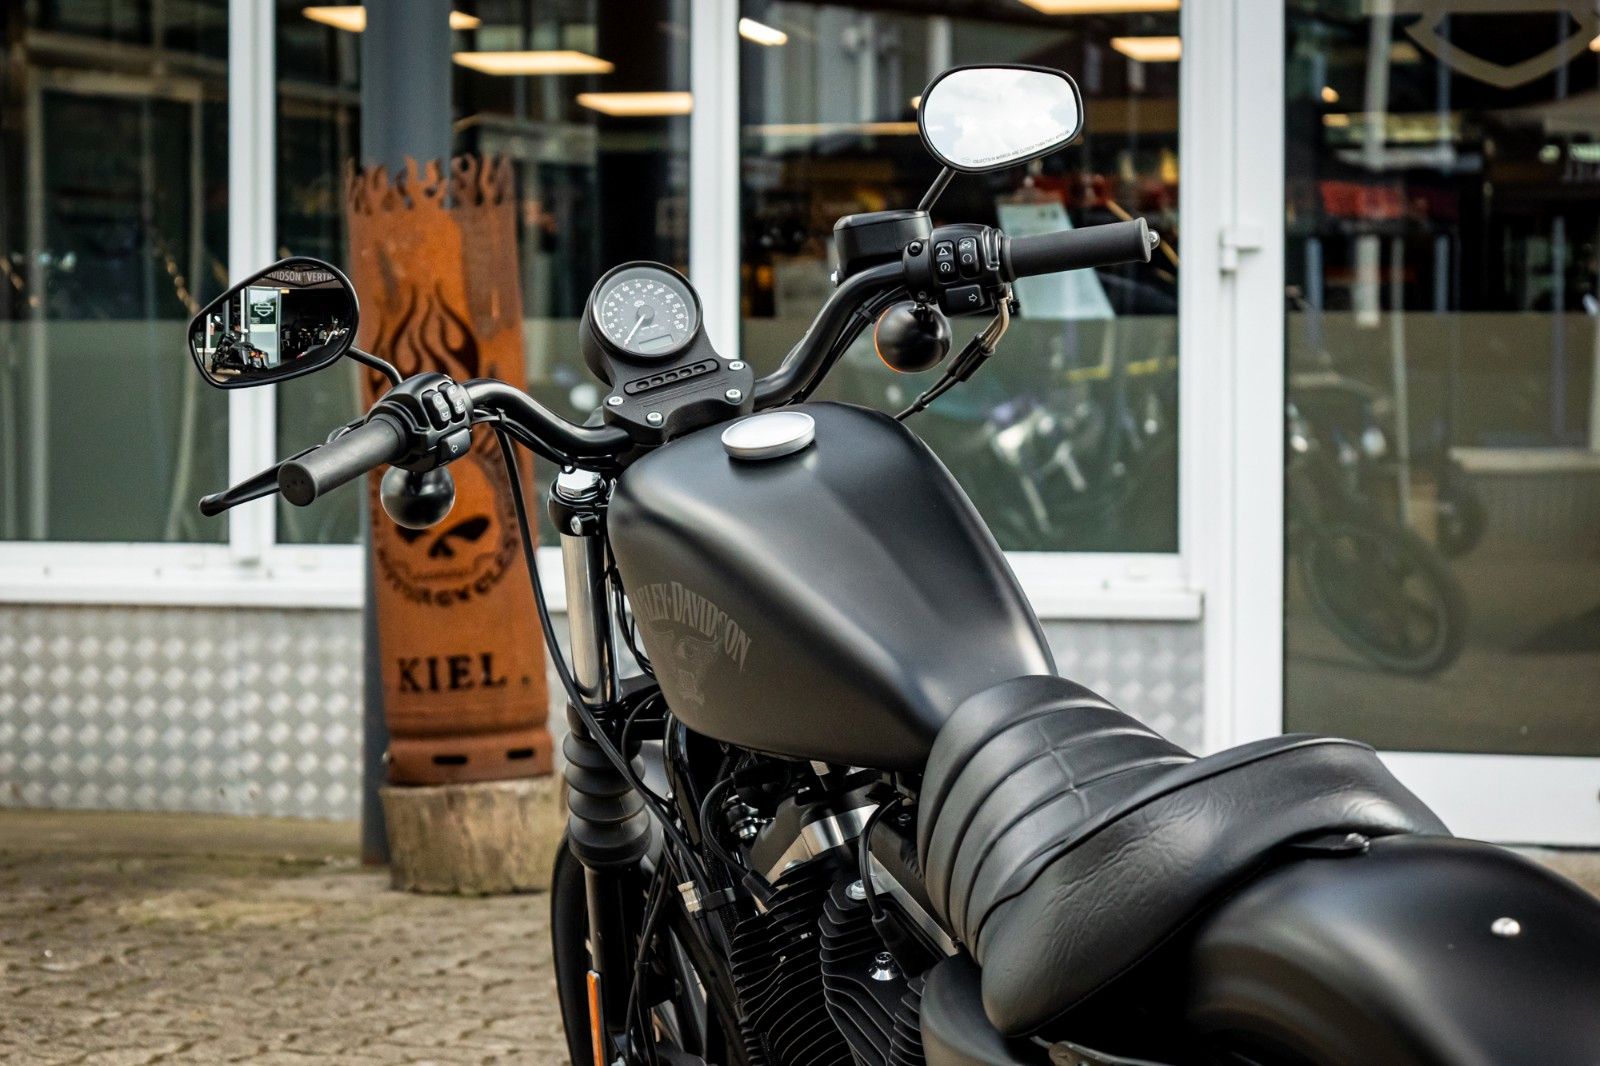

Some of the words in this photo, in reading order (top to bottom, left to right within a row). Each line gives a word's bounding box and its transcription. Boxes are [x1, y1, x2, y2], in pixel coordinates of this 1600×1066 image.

[265, 270, 301, 282] AVIDSON
[306, 271, 336, 282] VERTR
[631, 580, 752, 673] RLEY-DAVIDSON
[398, 652, 508, 692] KIEL
